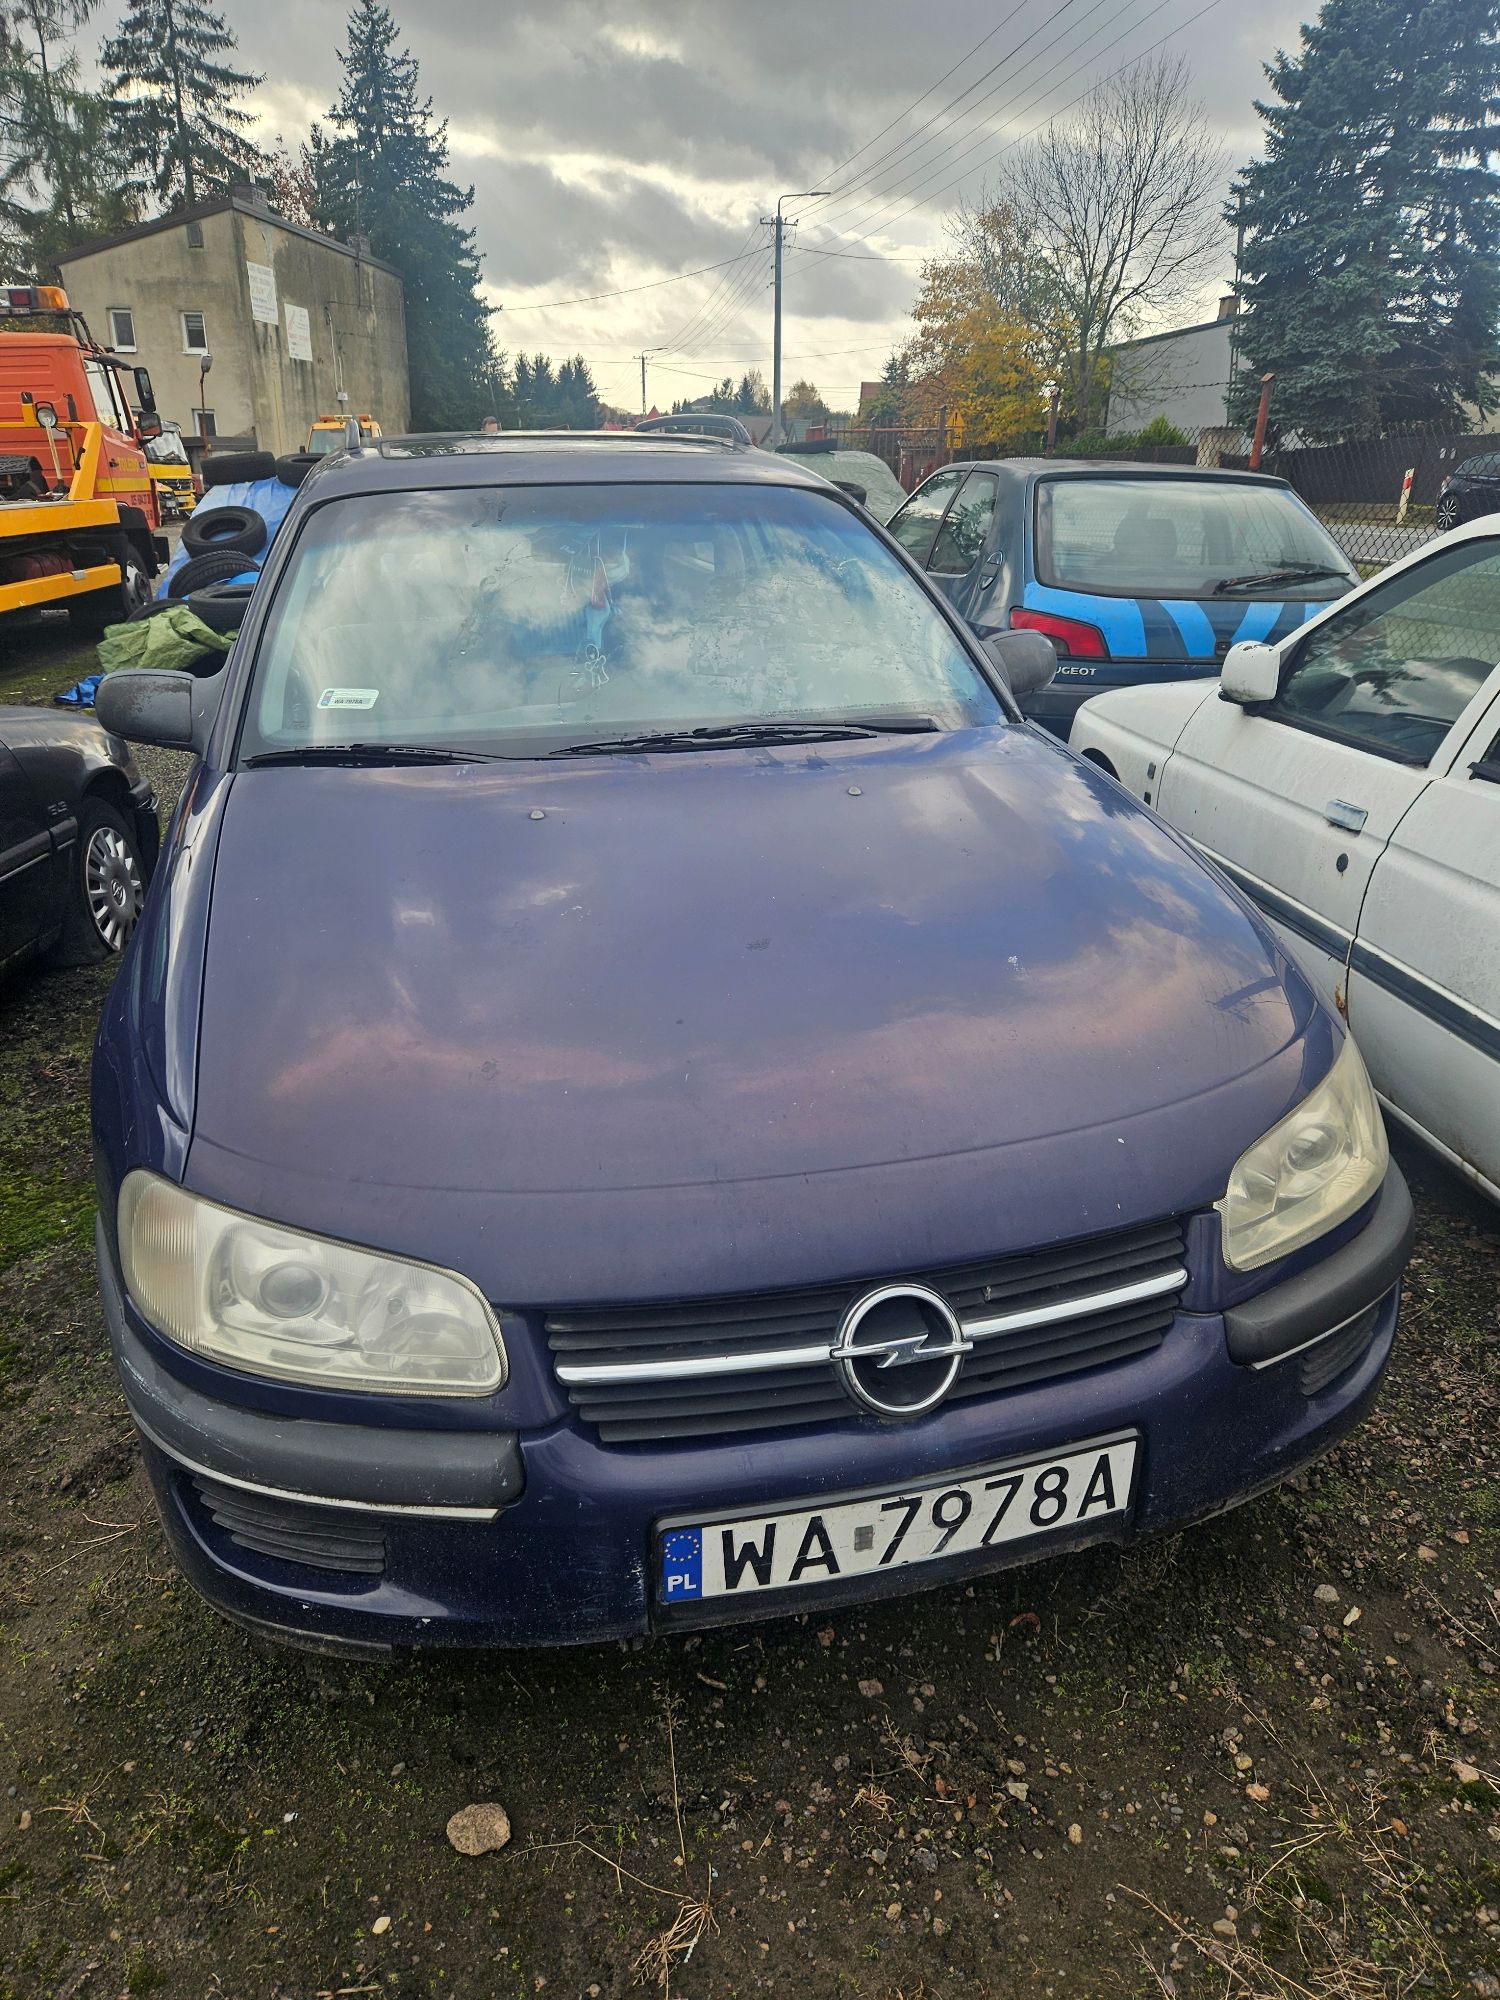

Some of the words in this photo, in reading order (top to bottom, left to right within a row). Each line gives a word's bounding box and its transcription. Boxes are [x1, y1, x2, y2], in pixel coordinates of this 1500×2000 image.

[1056, 666, 1097, 676] UGEOT
[722, 1515, 841, 1590] WA
[878, 1453, 1116, 1566] 7978A
[667, 1573, 697, 1593] PL
